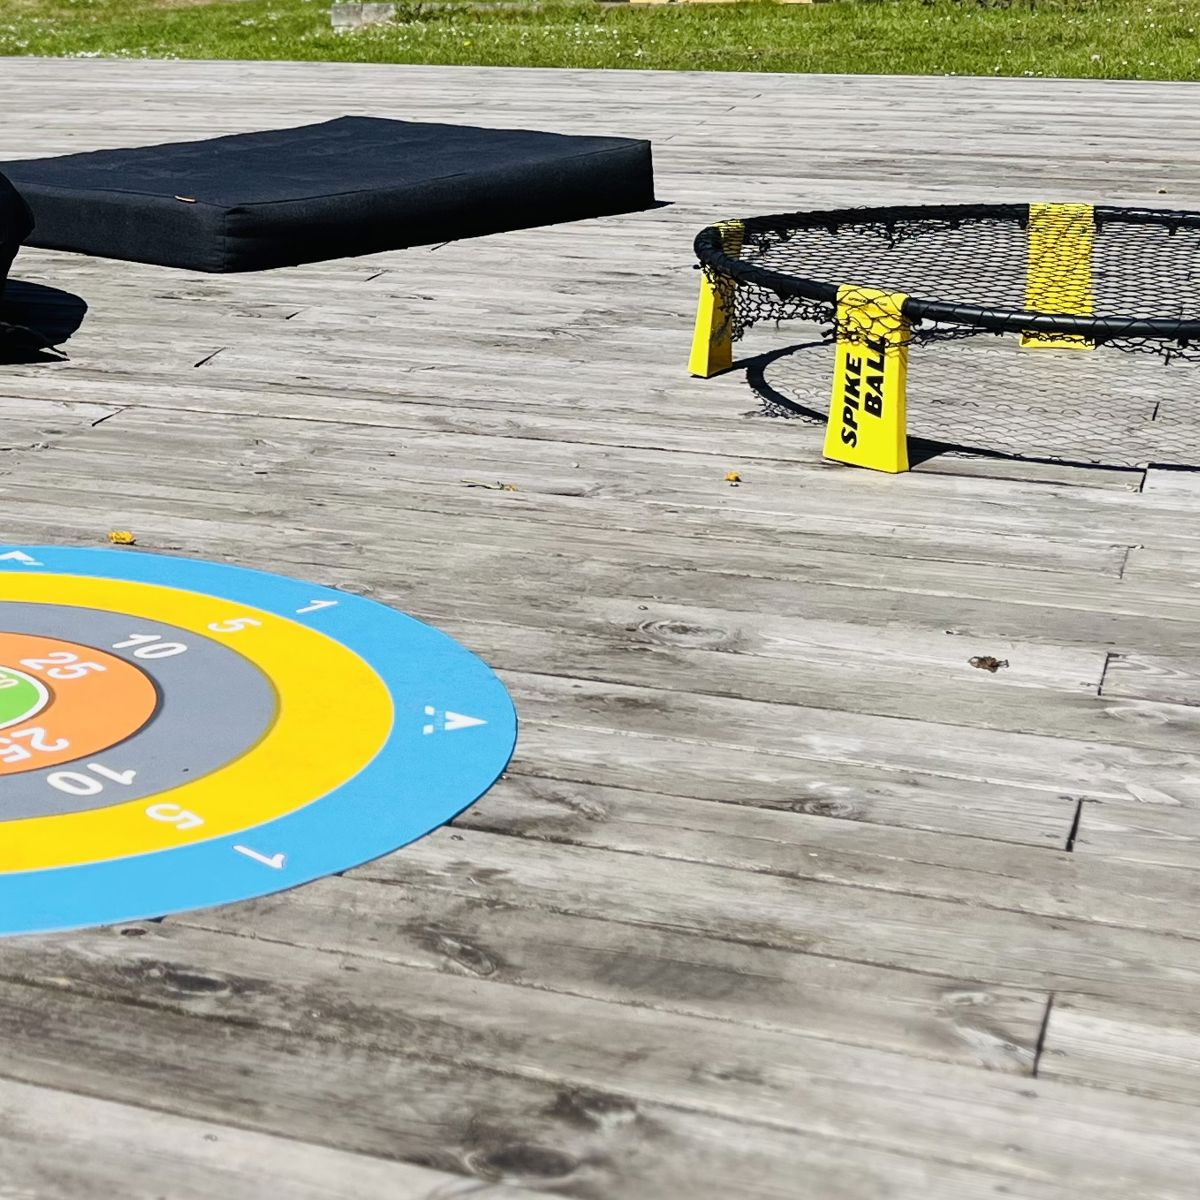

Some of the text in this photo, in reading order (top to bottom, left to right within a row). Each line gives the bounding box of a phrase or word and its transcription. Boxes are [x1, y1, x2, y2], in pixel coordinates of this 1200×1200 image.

[864, 336, 885, 419] BALL
[840, 352, 862, 448] SPIKE
[208, 616, 262, 633] 5
[111, 633, 188, 660] 10
[19, 650, 107, 681] 25
[45, 761, 138, 797] 10
[145, 802, 205, 831] 5
